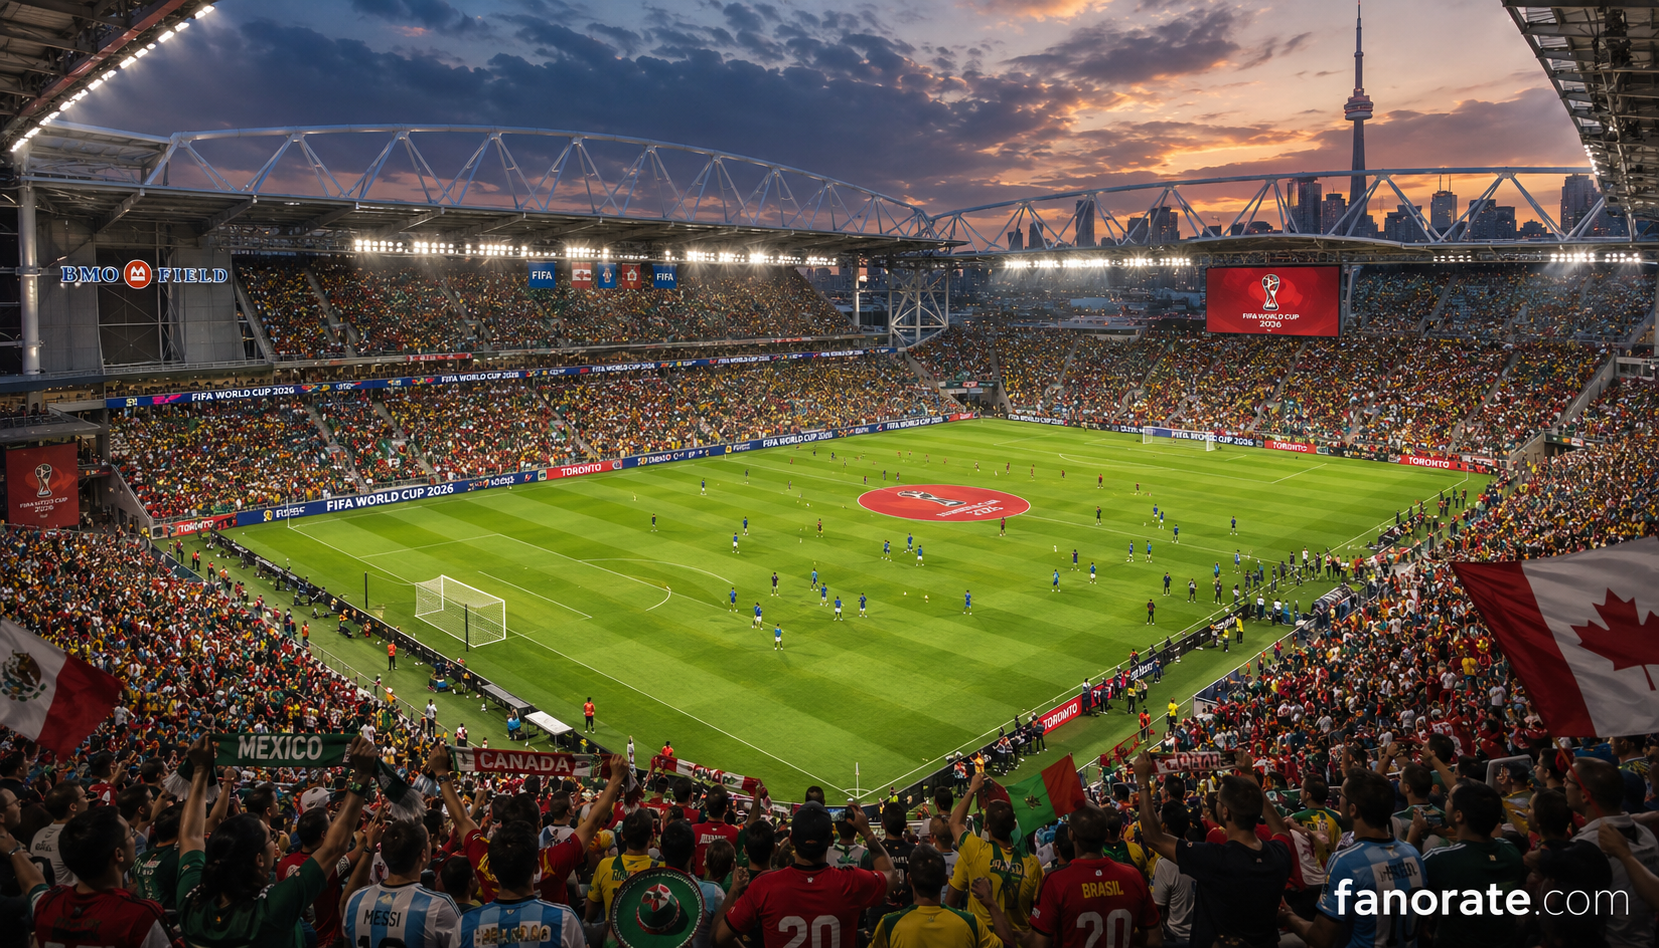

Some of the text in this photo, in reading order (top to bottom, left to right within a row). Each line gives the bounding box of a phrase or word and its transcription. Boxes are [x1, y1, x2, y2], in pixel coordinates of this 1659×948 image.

[60, 265, 229, 284] BMO FIELD
[531, 270, 553, 280] FIFA
[656, 272, 675, 281] FIFA
[487, 372, 502, 380] CUP
[192, 386, 295, 402] FIFA WORLD CUP 2026
[803, 433, 817, 442] CUP
[560, 463, 602, 477] TORONTO
[326, 483, 454, 512] FIFA WORLD CUP 2026
[237, 735, 323, 761] MEXICO
[479, 751, 571, 773] CANADA
[1081, 880, 1124, 899] BRASIL
[363, 909, 402, 928] MESSI
[1076, 908, 1132, 948] 20
[778, 914, 840, 948] 20
